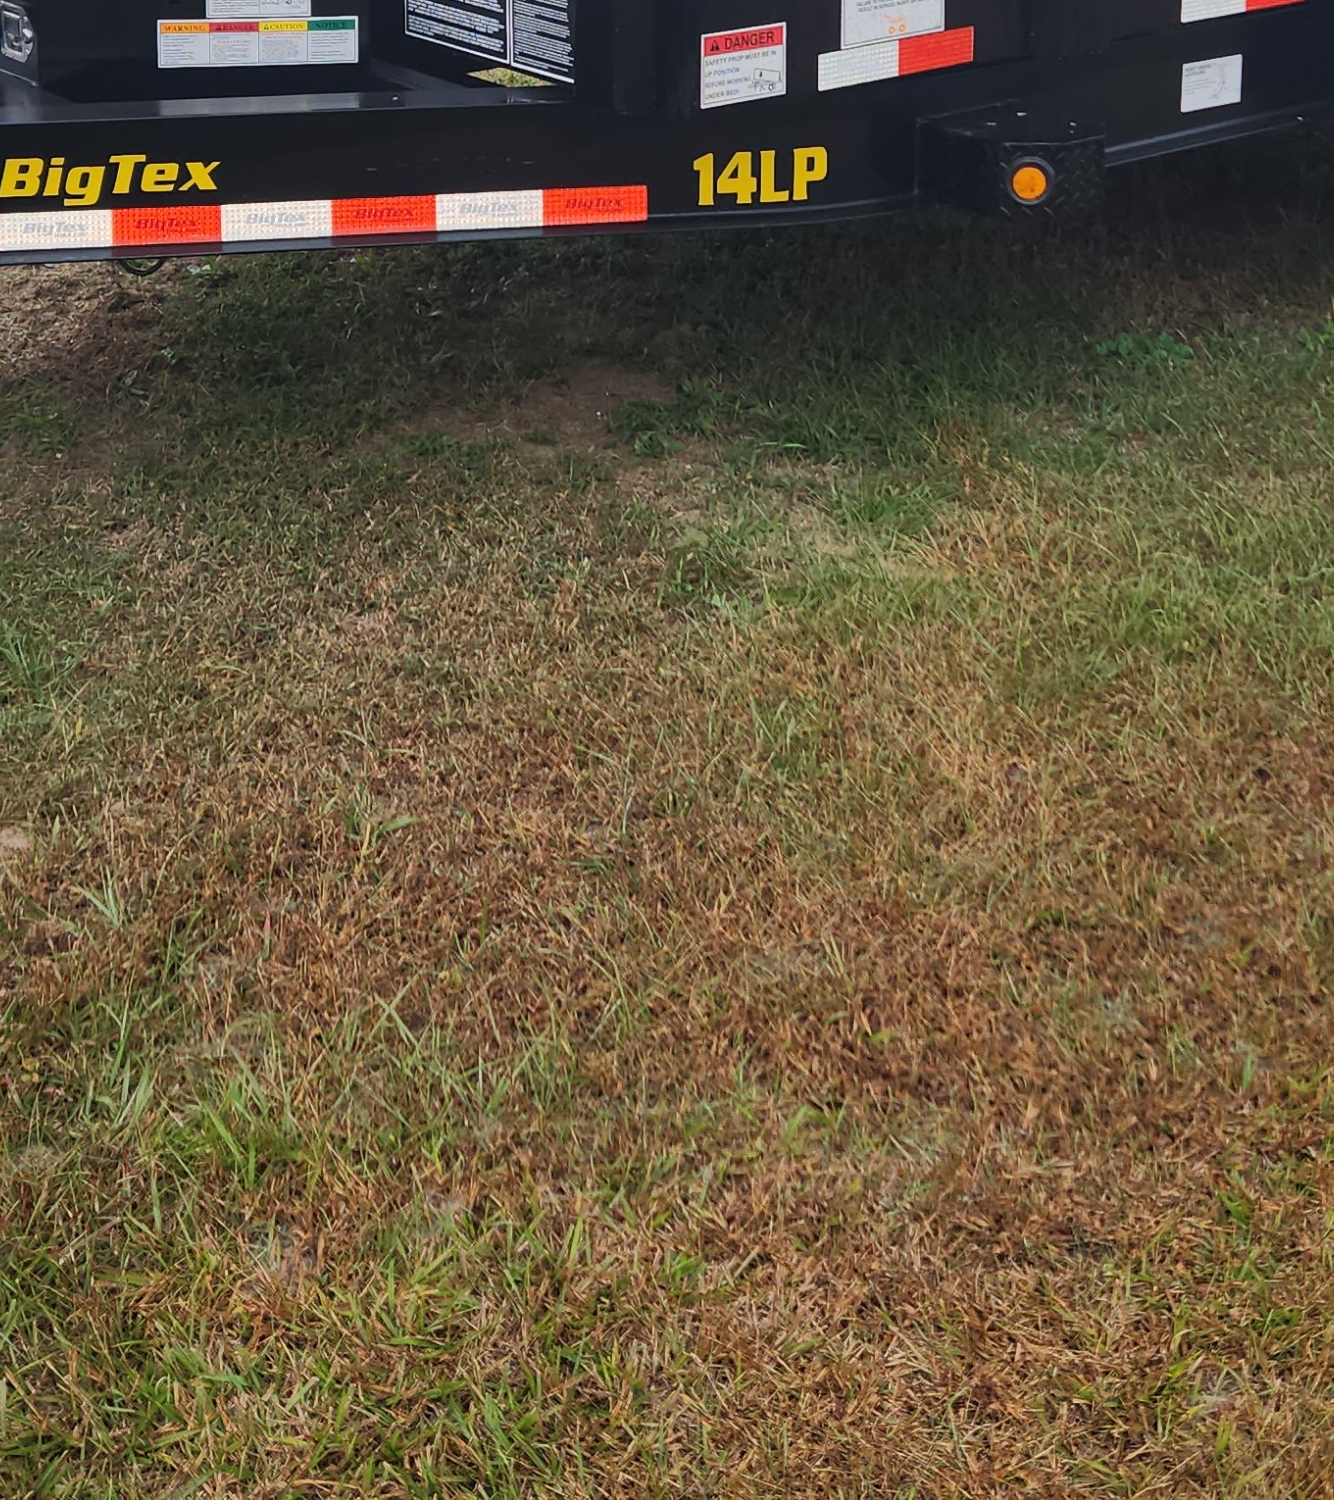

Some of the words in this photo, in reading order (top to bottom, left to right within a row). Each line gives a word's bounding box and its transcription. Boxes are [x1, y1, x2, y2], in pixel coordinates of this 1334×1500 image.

[724, 31, 775, 50] DANGER
[704, 57, 727, 67] SAFETY
[728, 54, 744, 63] PROP
[745, 52, 760, 60] MUST
[713, 66, 740, 76] POSITION
[693, 146, 828, 206] 14LP
[355, 207, 415, 220] BigTex
[460, 202, 518, 214] BigTex
[245, 212, 305, 225] BigTex
[23, 221, 87, 235] BigTex
